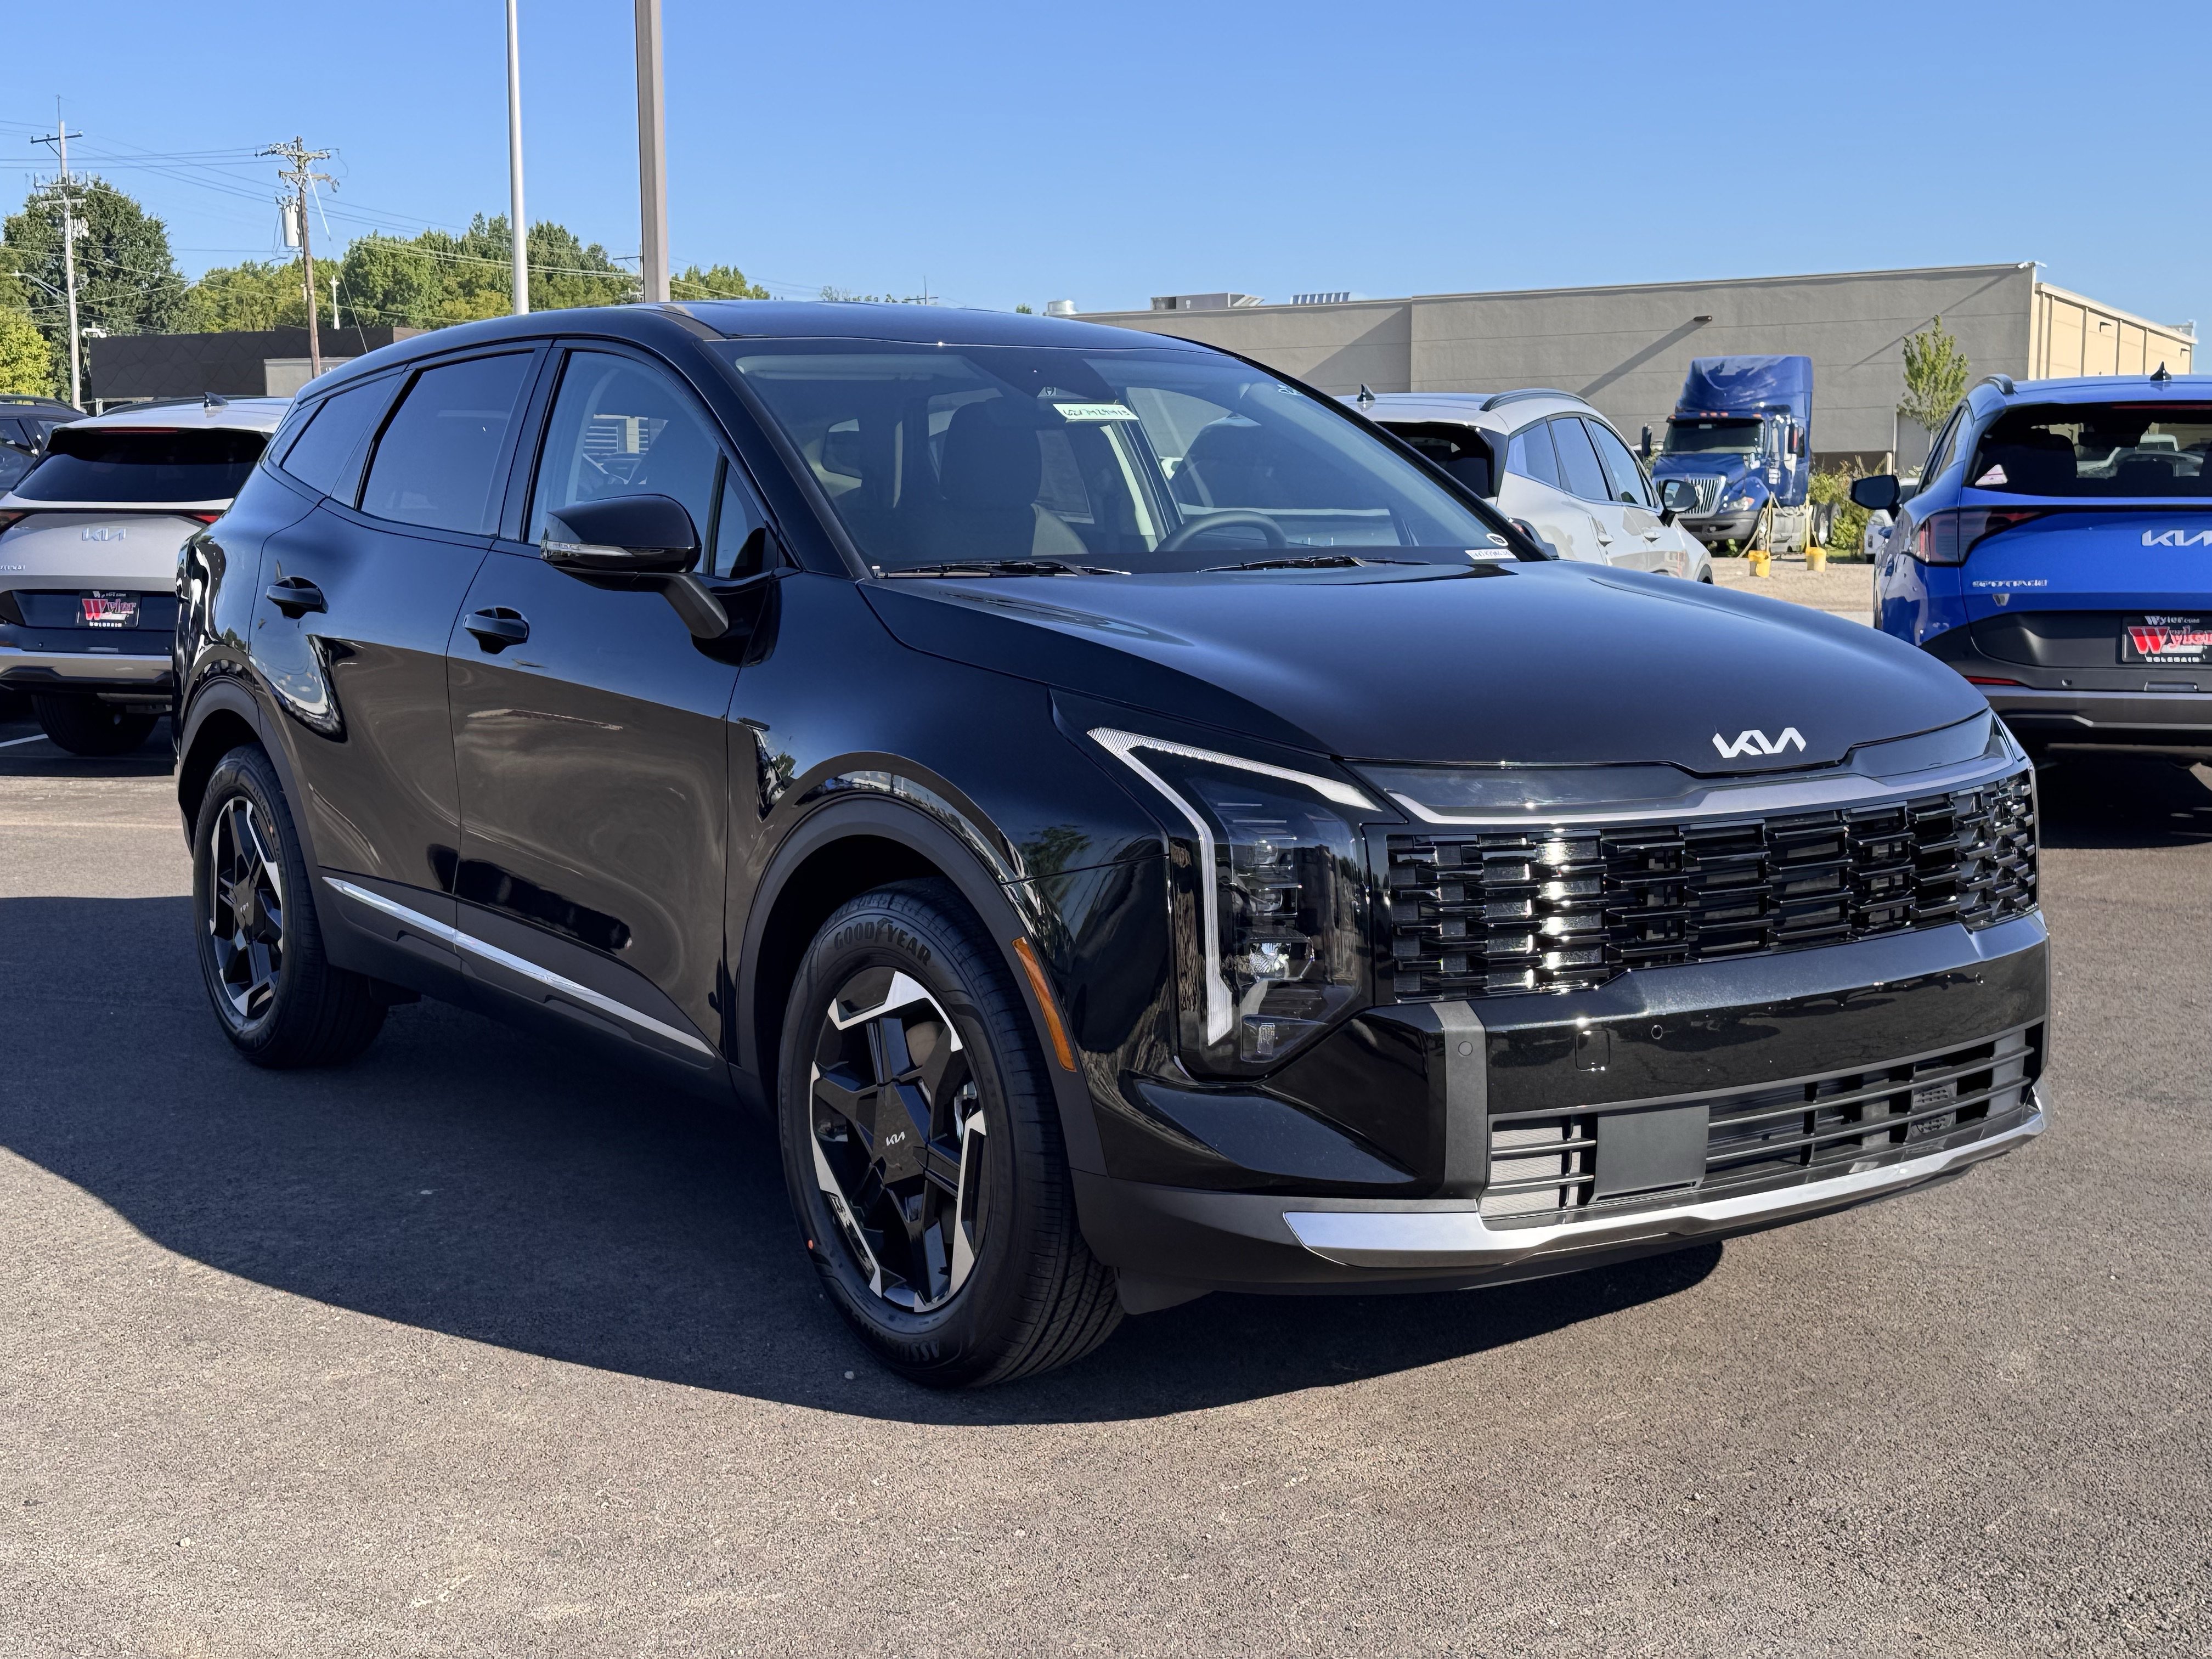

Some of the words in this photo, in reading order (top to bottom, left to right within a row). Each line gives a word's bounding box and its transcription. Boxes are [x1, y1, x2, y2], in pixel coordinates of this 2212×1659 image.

[82, 527, 127, 541] KIA
[2142, 529, 2212, 546] KIA
[1712, 727, 1807, 758] KIA
[834, 919, 932, 966] GOODYEAR
[885, 1131, 905, 1146] KIA
